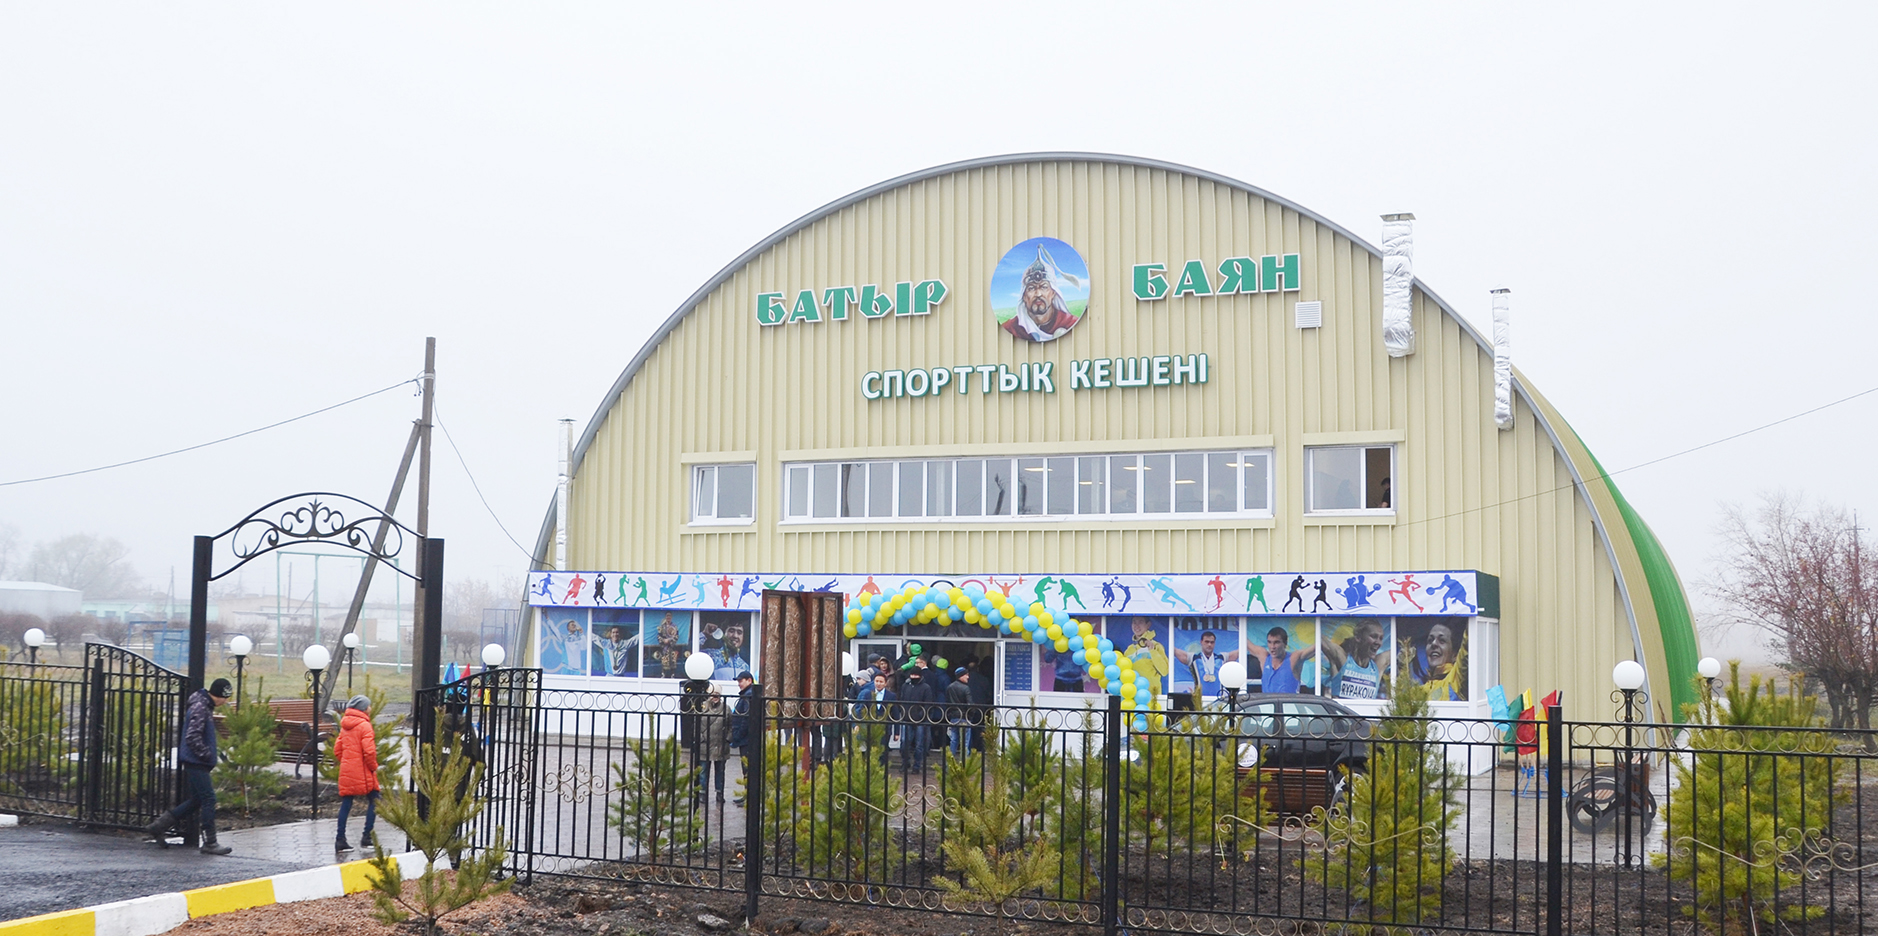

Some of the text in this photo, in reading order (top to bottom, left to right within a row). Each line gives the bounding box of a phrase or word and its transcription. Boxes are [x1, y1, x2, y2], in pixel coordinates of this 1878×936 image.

[756, 253, 1301, 326] БАТЫР БАЯН
[1070, 353, 1209, 389] КЕШЕНІ
